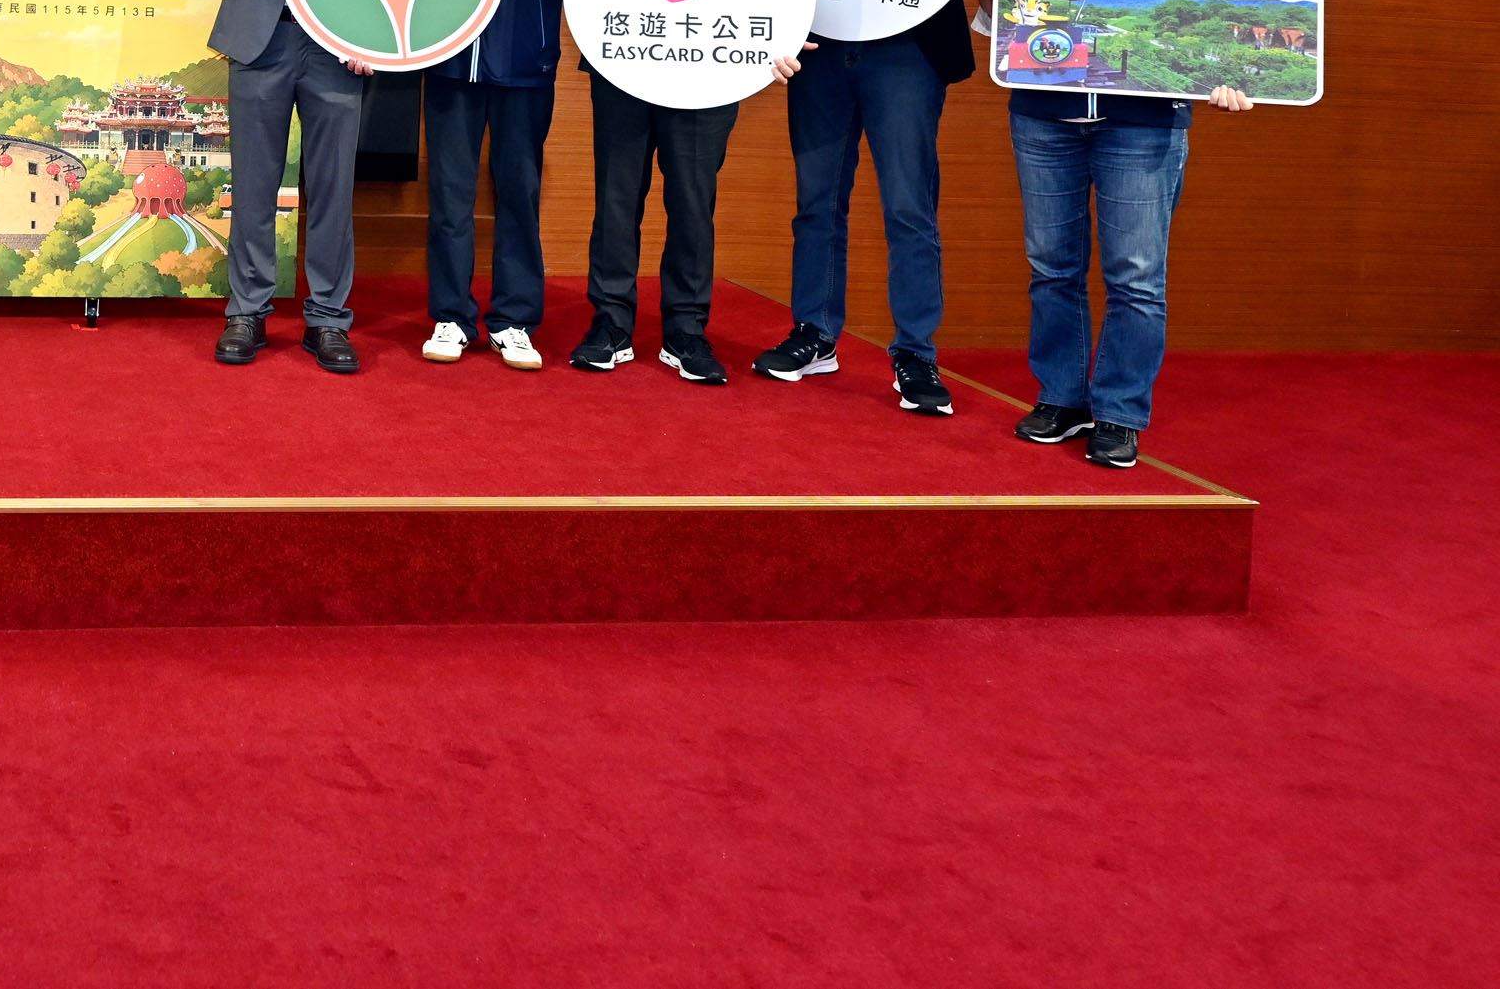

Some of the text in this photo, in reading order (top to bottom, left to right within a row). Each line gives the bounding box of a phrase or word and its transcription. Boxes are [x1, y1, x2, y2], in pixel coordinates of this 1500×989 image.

[603, 11, 773, 41] 悠遊卡公司
